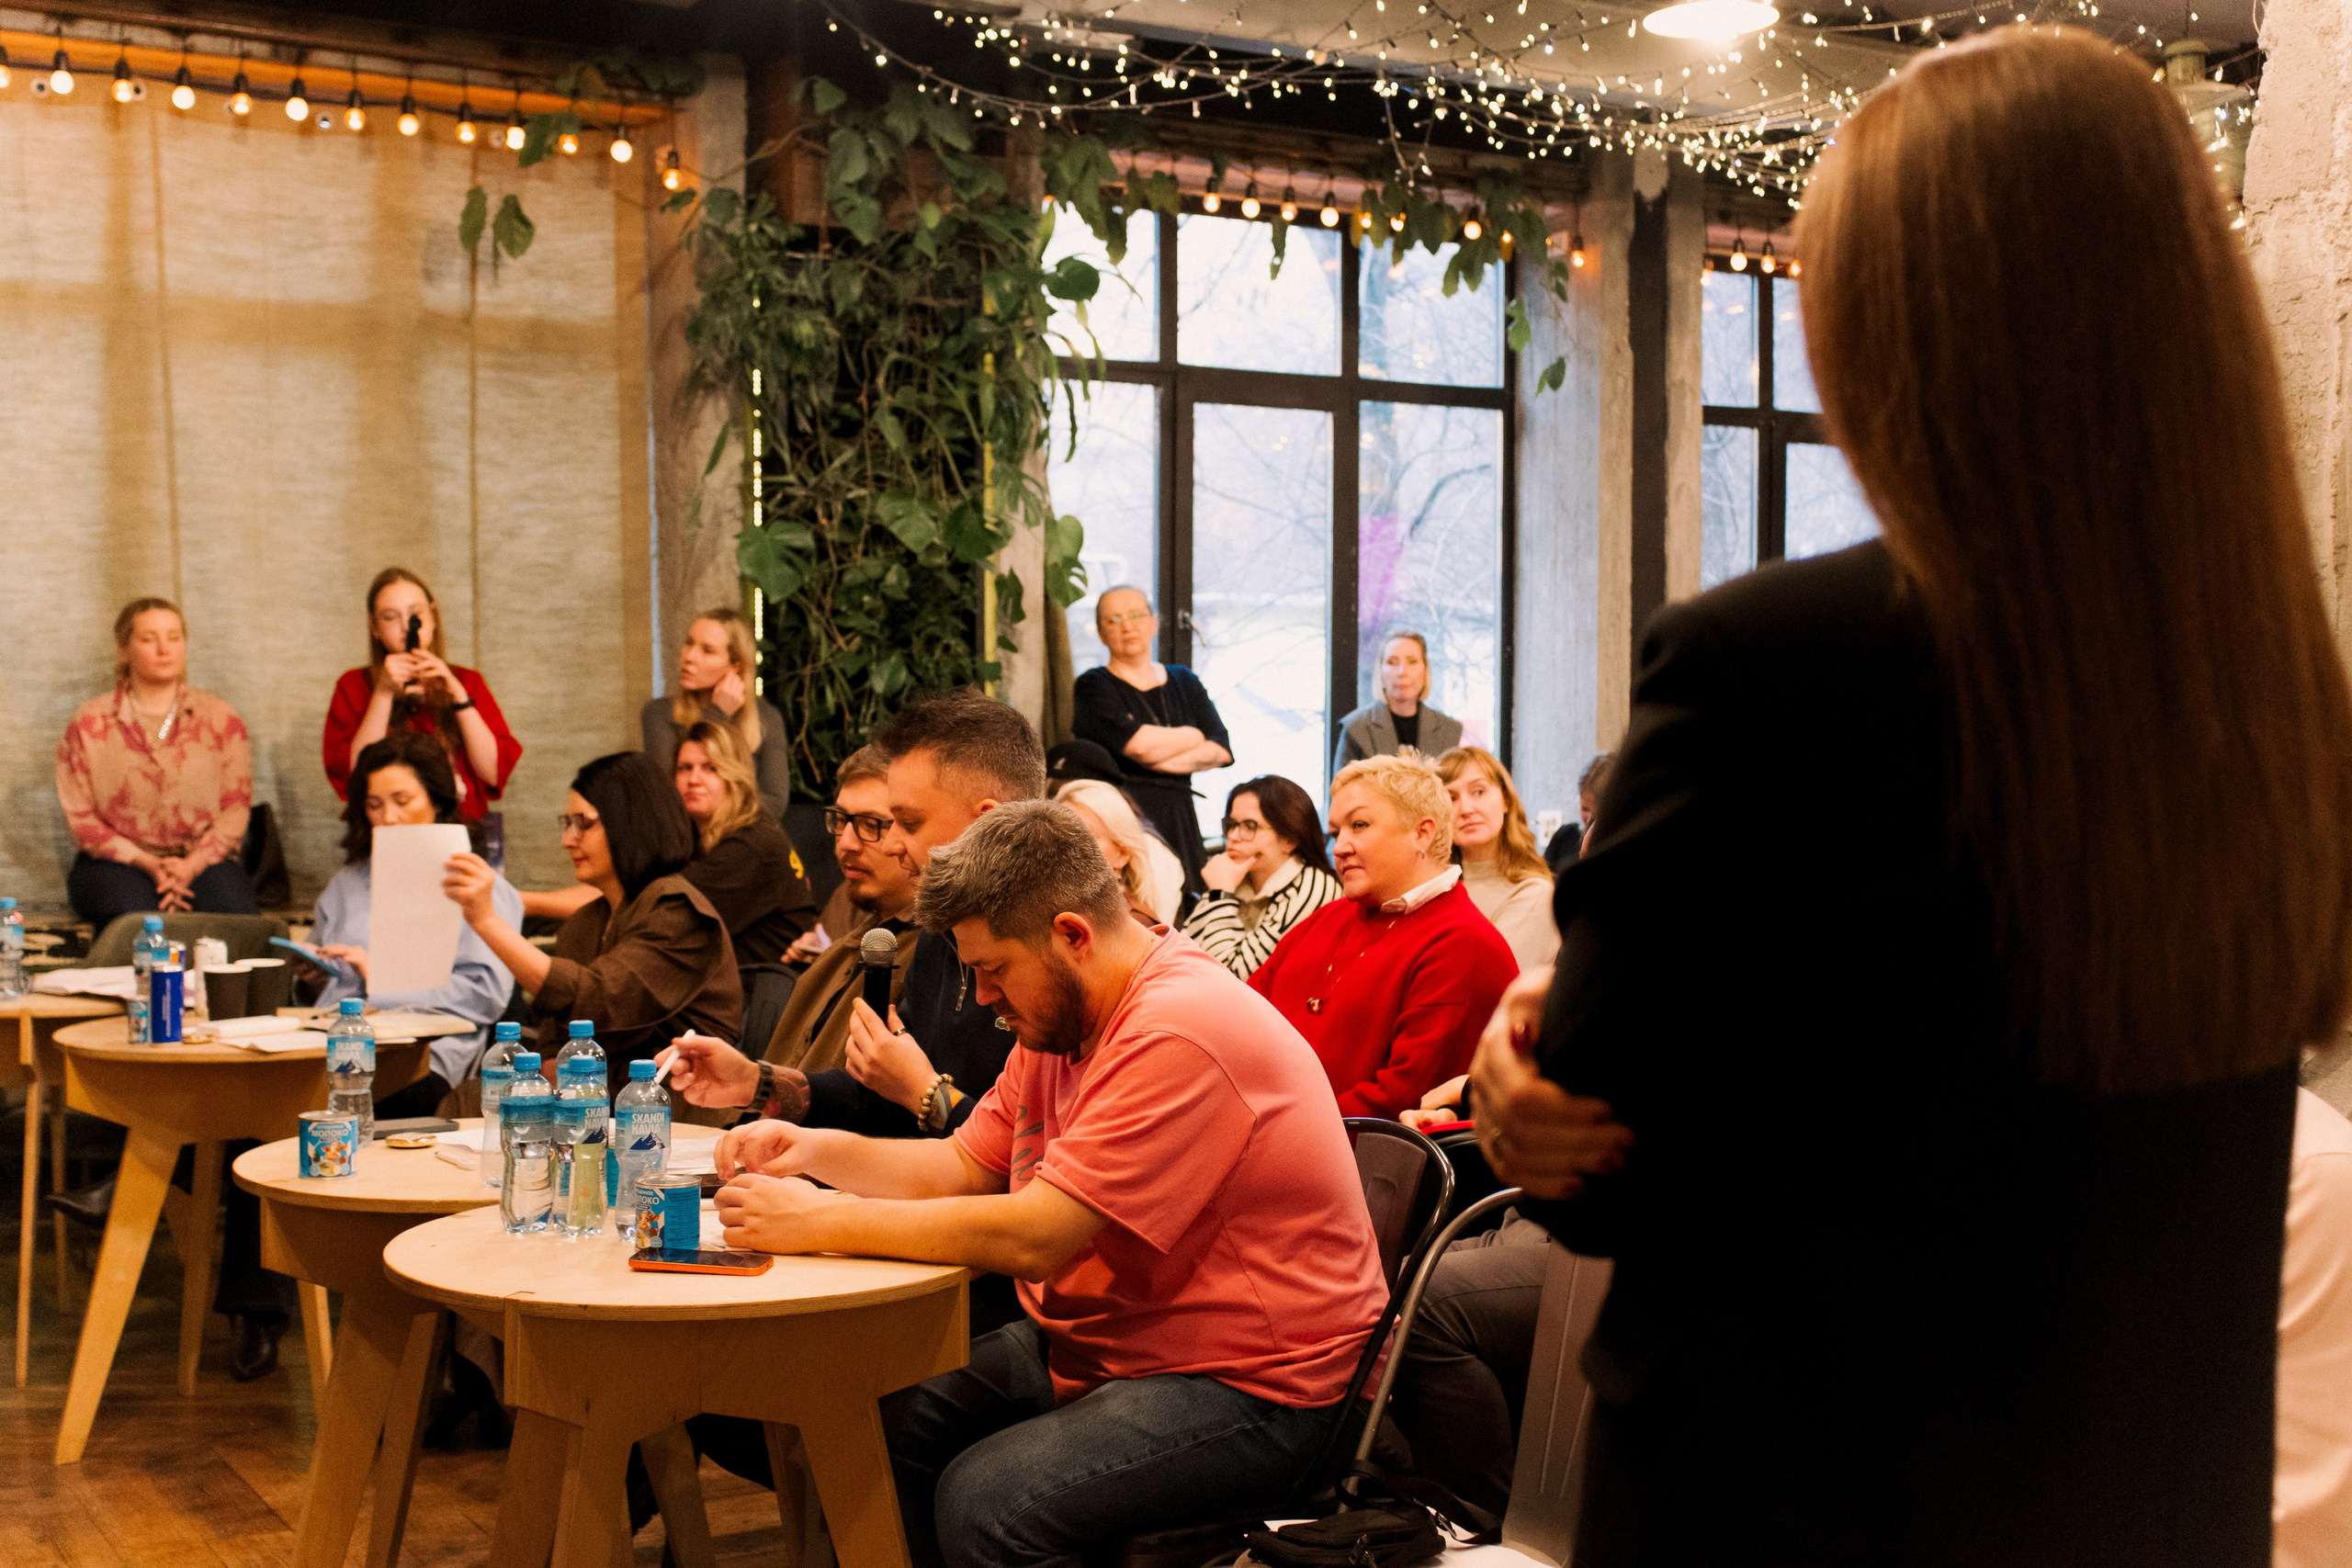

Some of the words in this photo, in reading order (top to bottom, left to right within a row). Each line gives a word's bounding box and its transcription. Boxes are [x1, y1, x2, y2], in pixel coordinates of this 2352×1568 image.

[631, 1112, 665, 1123] SKANDI
[311, 1129, 349, 1137] МОЛОКО
[631, 1123, 661, 1134] NAVIA
